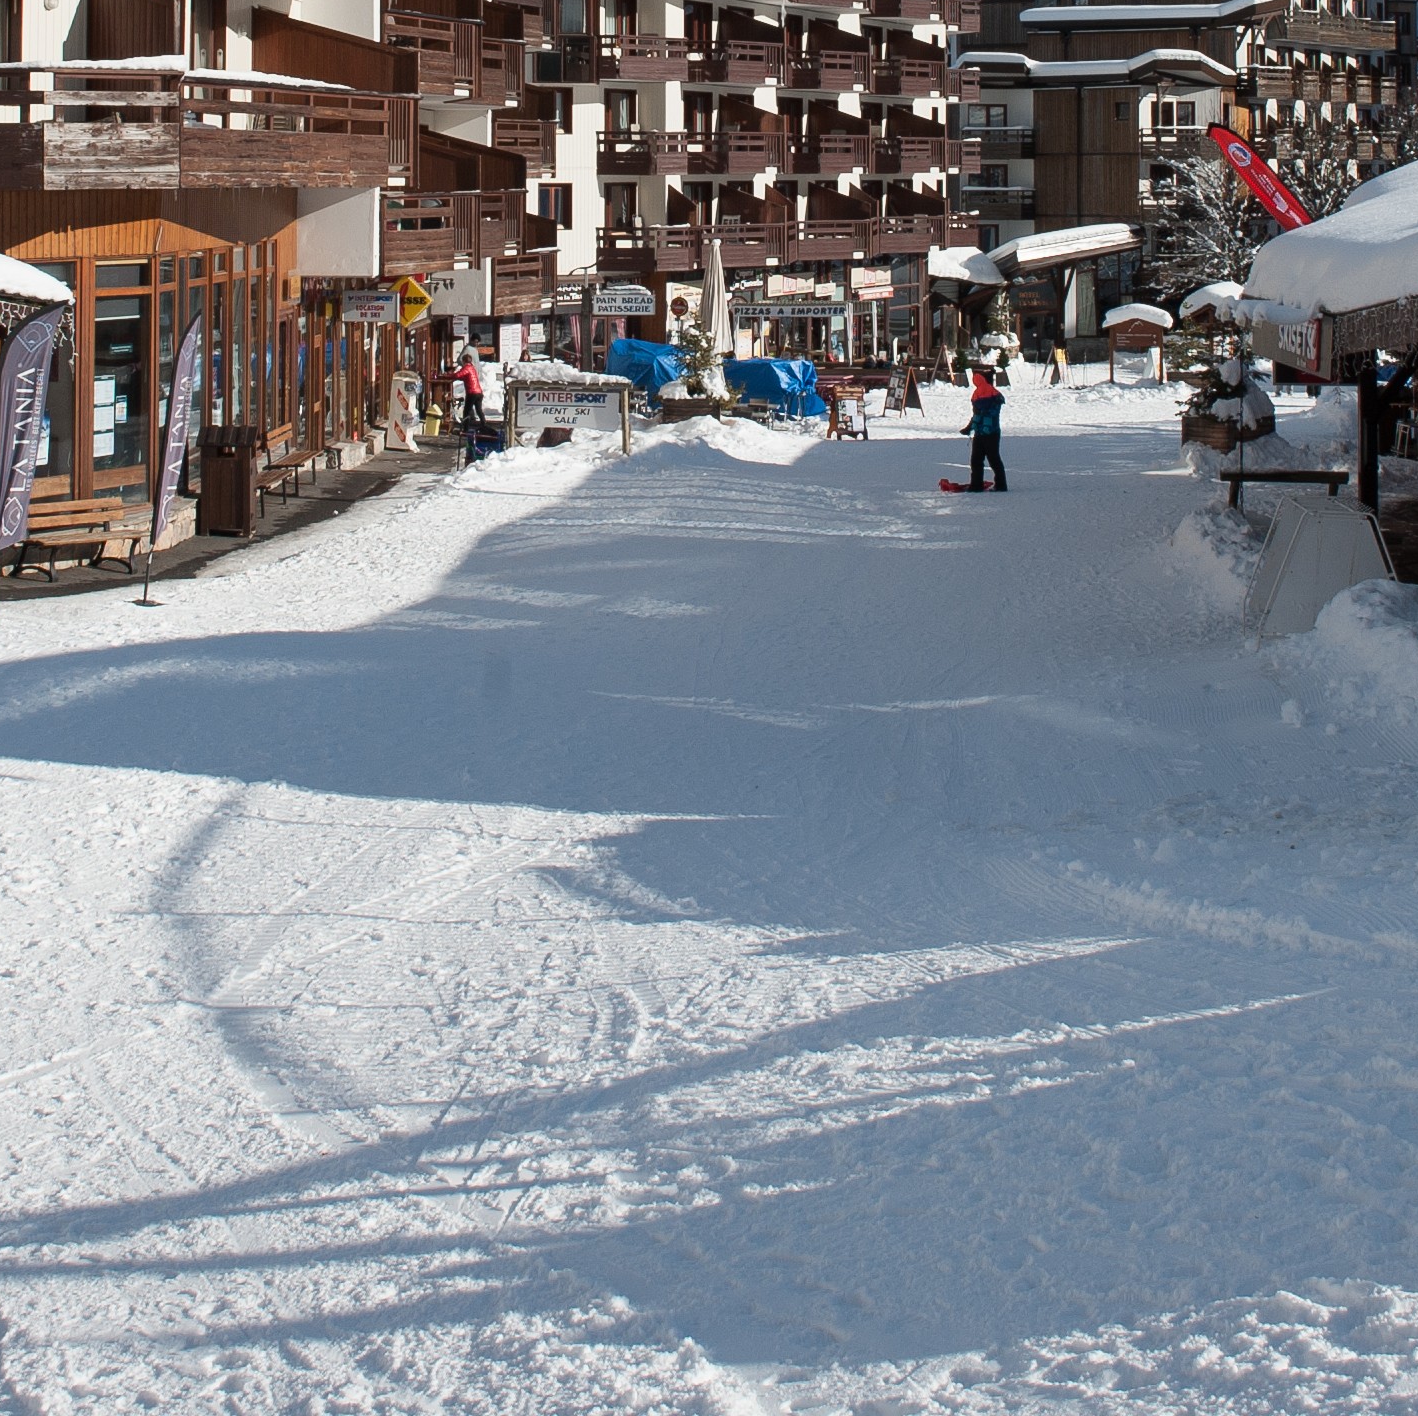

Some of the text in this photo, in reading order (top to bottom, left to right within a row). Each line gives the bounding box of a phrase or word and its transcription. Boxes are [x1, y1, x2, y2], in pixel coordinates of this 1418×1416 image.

[596, 296, 653, 304] PAIN BREAD
[355, 304, 385, 312] LOCATION
[597, 305, 651, 313] PATISSERIE
[734, 306, 847, 315] PIZZAS A EMPORTER
[1278, 324, 1307, 358] SKISET
[538, 392, 608, 404] INTERSPORT
[542, 406, 590, 416] RENT SKI
[554, 416, 579, 424] SALE
[10, 367, 36, 492] LA TANIA
